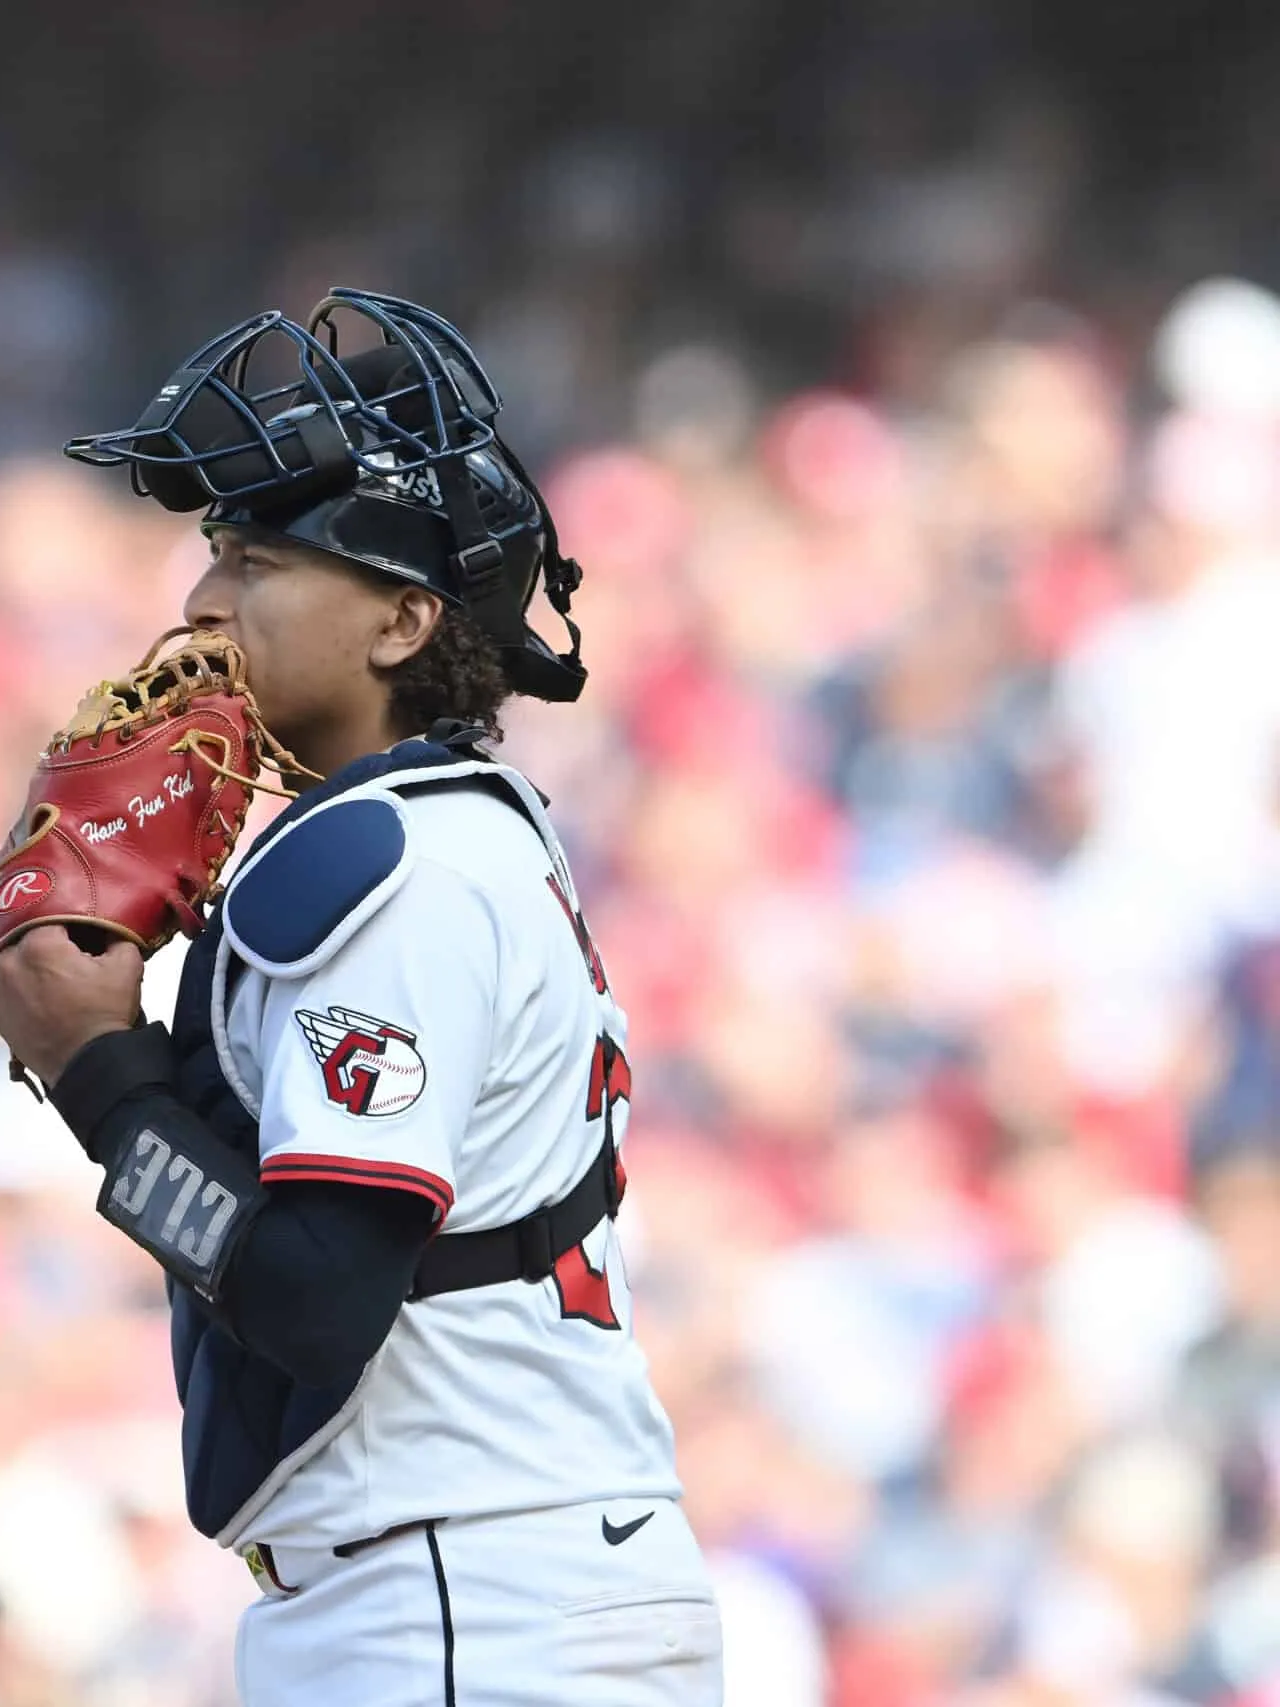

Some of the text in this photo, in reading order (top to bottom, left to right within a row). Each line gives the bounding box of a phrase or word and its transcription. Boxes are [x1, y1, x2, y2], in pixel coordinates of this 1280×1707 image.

[80, 770, 194, 844] Have Fun Kid
[110, 1129, 237, 1267] CLE
